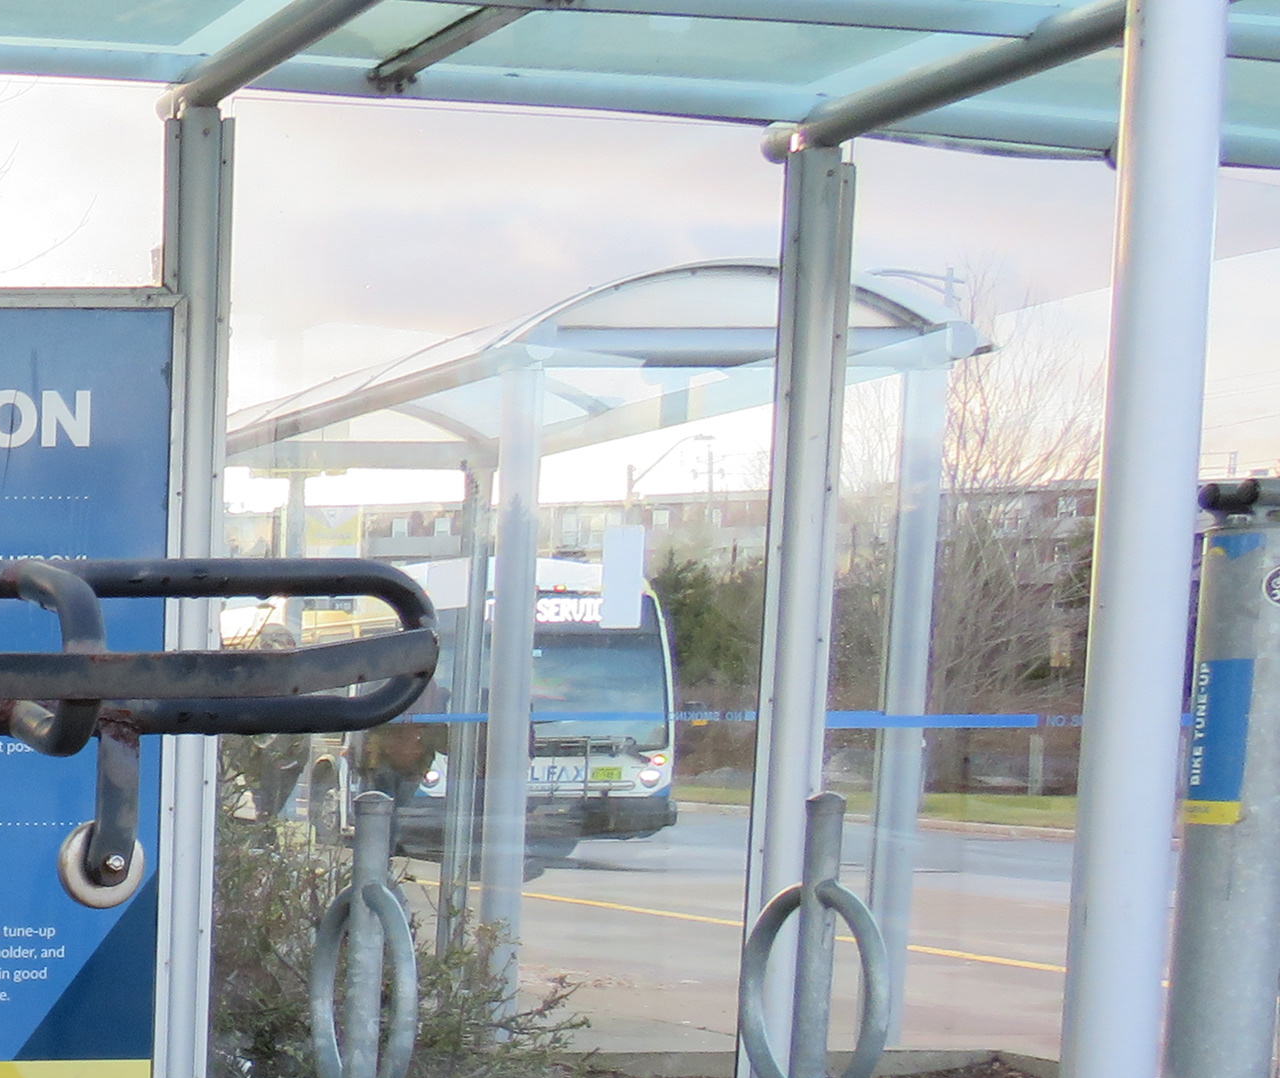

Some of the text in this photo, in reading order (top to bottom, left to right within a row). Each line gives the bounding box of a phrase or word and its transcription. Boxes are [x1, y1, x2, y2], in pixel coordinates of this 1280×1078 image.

[1193, 661, 1211, 739] TUNE-UP
[530, 766, 585, 781] LIFAX
[1190, 746, 1205, 786] BIKE
[3, 925, 56, 941] tune-up
[40, 945, 65, 959] and
[13, 967, 48, 983] good
